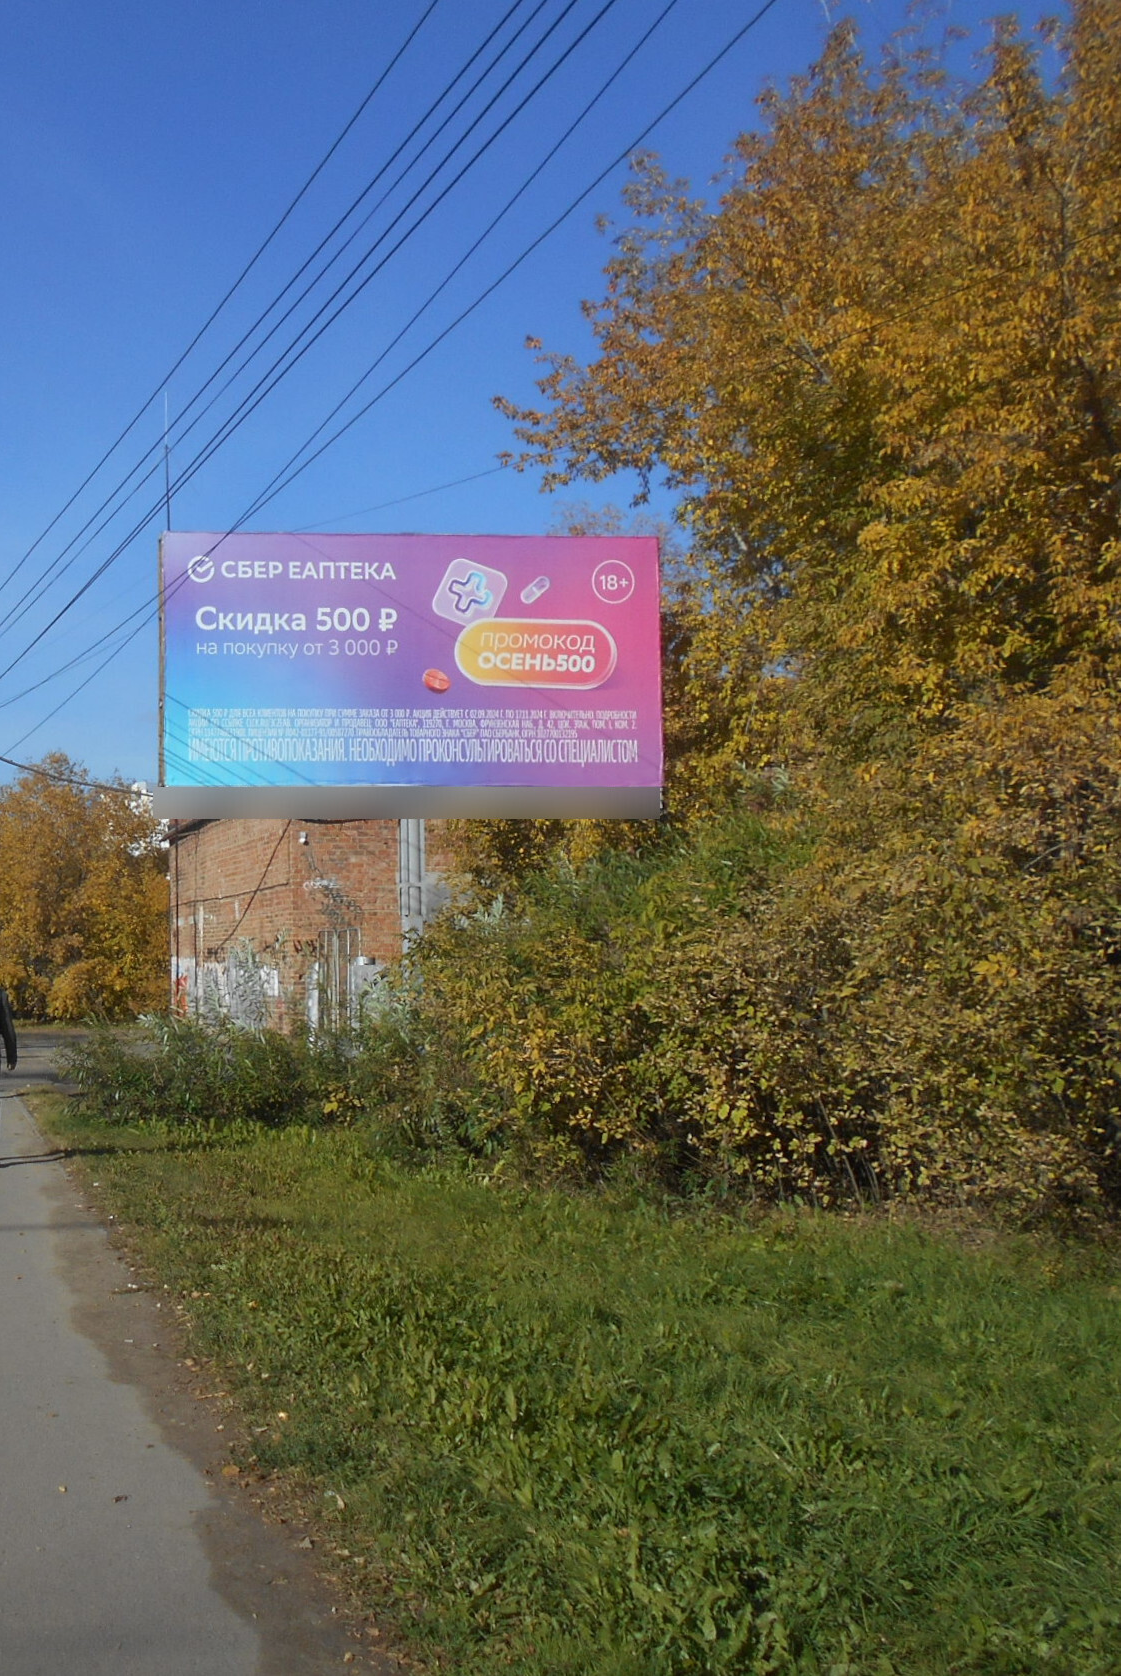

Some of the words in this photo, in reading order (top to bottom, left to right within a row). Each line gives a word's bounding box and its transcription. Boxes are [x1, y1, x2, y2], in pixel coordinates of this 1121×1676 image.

[221, 560, 283, 579] СБЕР
[288, 561, 397, 580] ЕАПТЕКА
[599, 574, 629, 591] 18+
[195, 606, 307, 634] Скидка
[316, 607, 370, 631] 500
[379, 608, 398, 632] ₽
[196, 641, 218, 655] на
[223, 642, 299, 659] покупку
[303, 642, 324, 656] от
[329, 639, 340, 656] 3
[344, 640, 381, 656] 000
[478, 652, 596, 673] ОСЕНЬ500
[349, 738, 417, 766] НЕОБХОДИМО
[419, 738, 542, 762] ПРОКОНСУЛЬТИРОВАТЬСЯ
[544, 739, 557, 762] СО
[559, 739, 638, 767] СПЕЦИАЛИСТОМ
